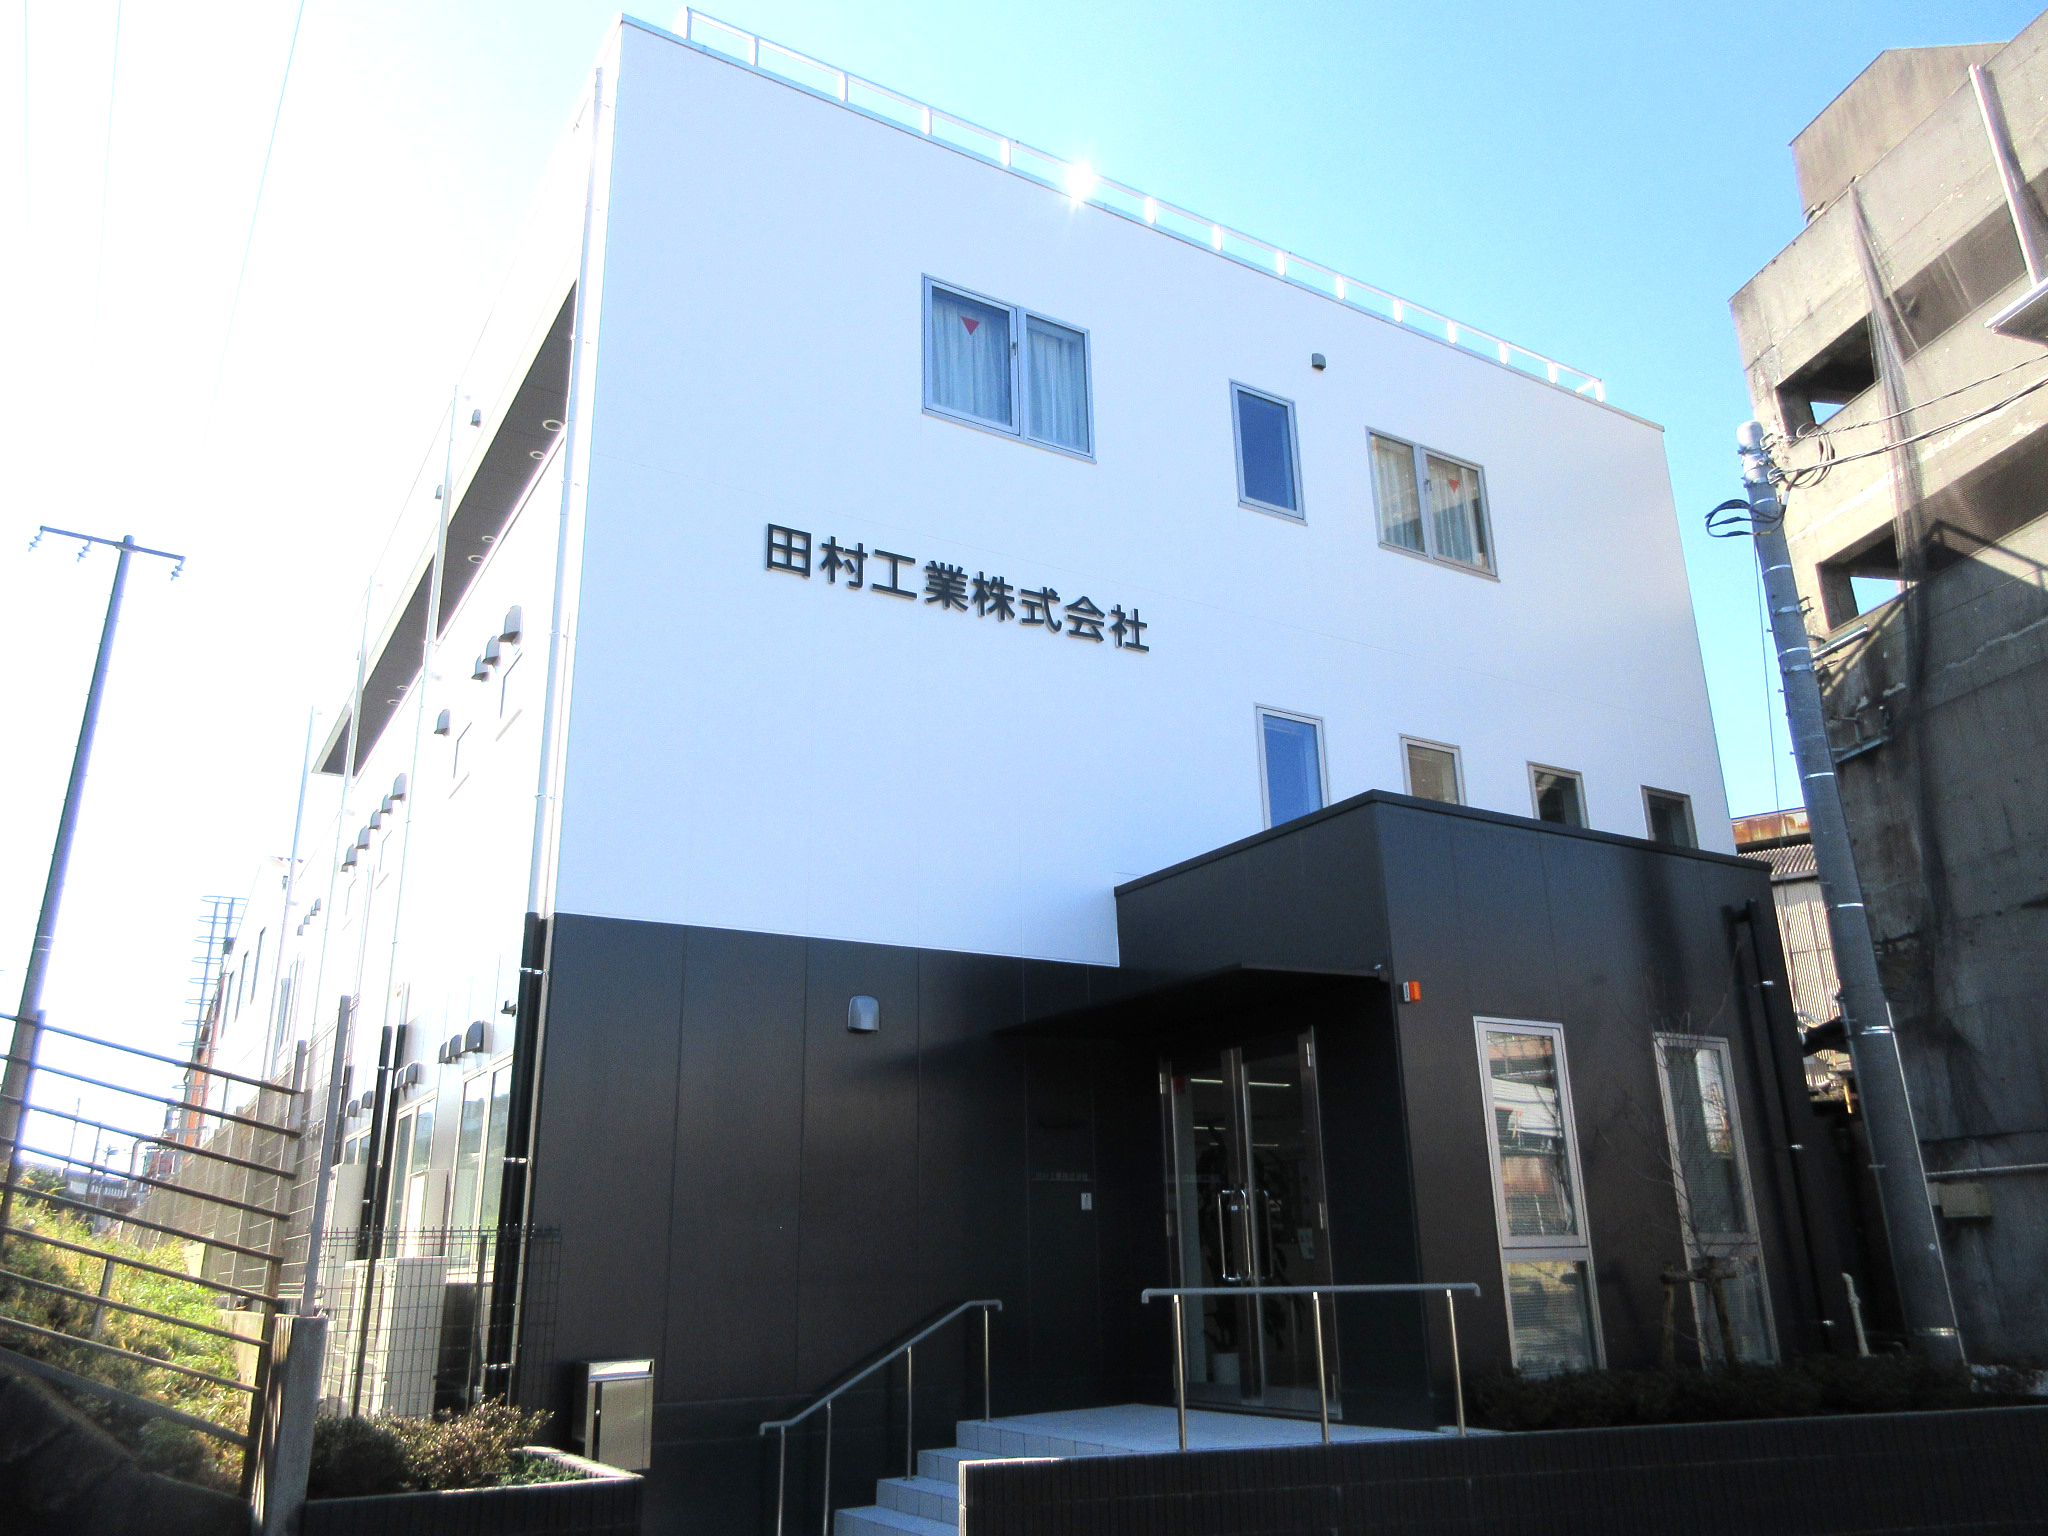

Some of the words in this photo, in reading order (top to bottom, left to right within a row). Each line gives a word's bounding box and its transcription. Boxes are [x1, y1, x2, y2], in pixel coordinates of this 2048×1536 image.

[766, 523, 1150, 652] 田村工業株式会社
